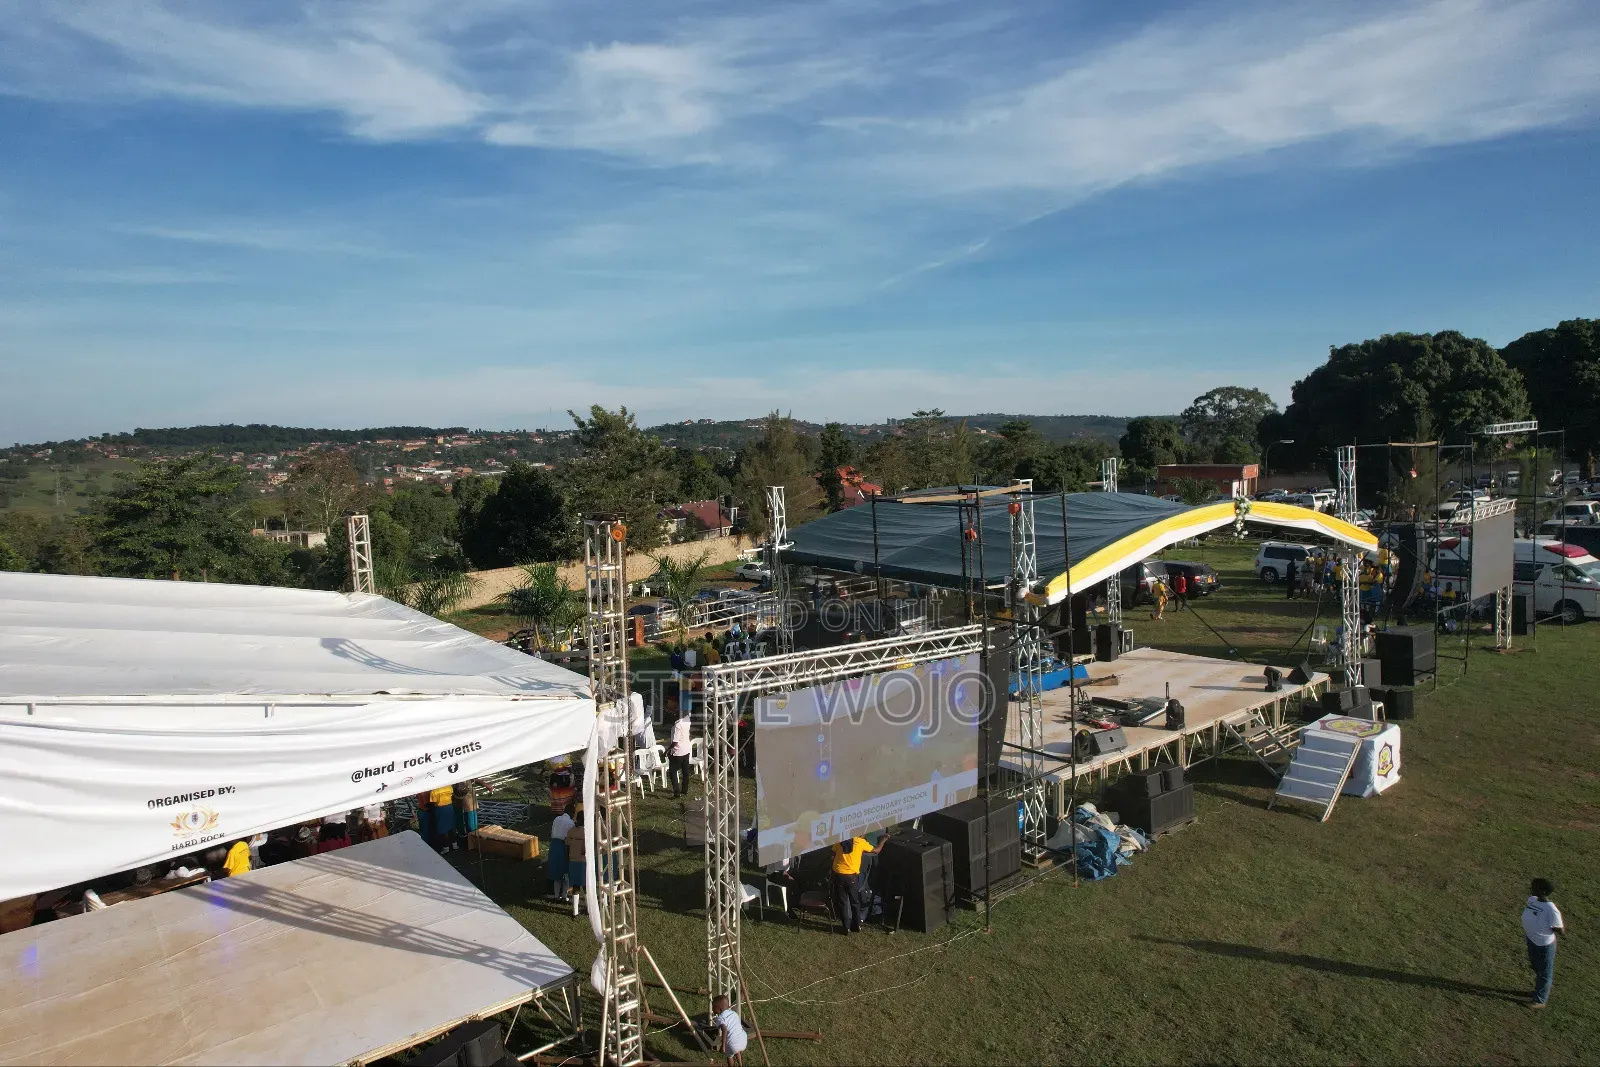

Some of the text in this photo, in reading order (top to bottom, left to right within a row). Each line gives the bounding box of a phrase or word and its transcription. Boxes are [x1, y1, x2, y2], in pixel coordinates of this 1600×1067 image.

[147, 789, 215, 810] ORGANISED
[864, 799, 901, 816] SECONDARY
[902, 790, 928, 804] SCHOOL
[171, 832, 226, 851] HARD ROCK
